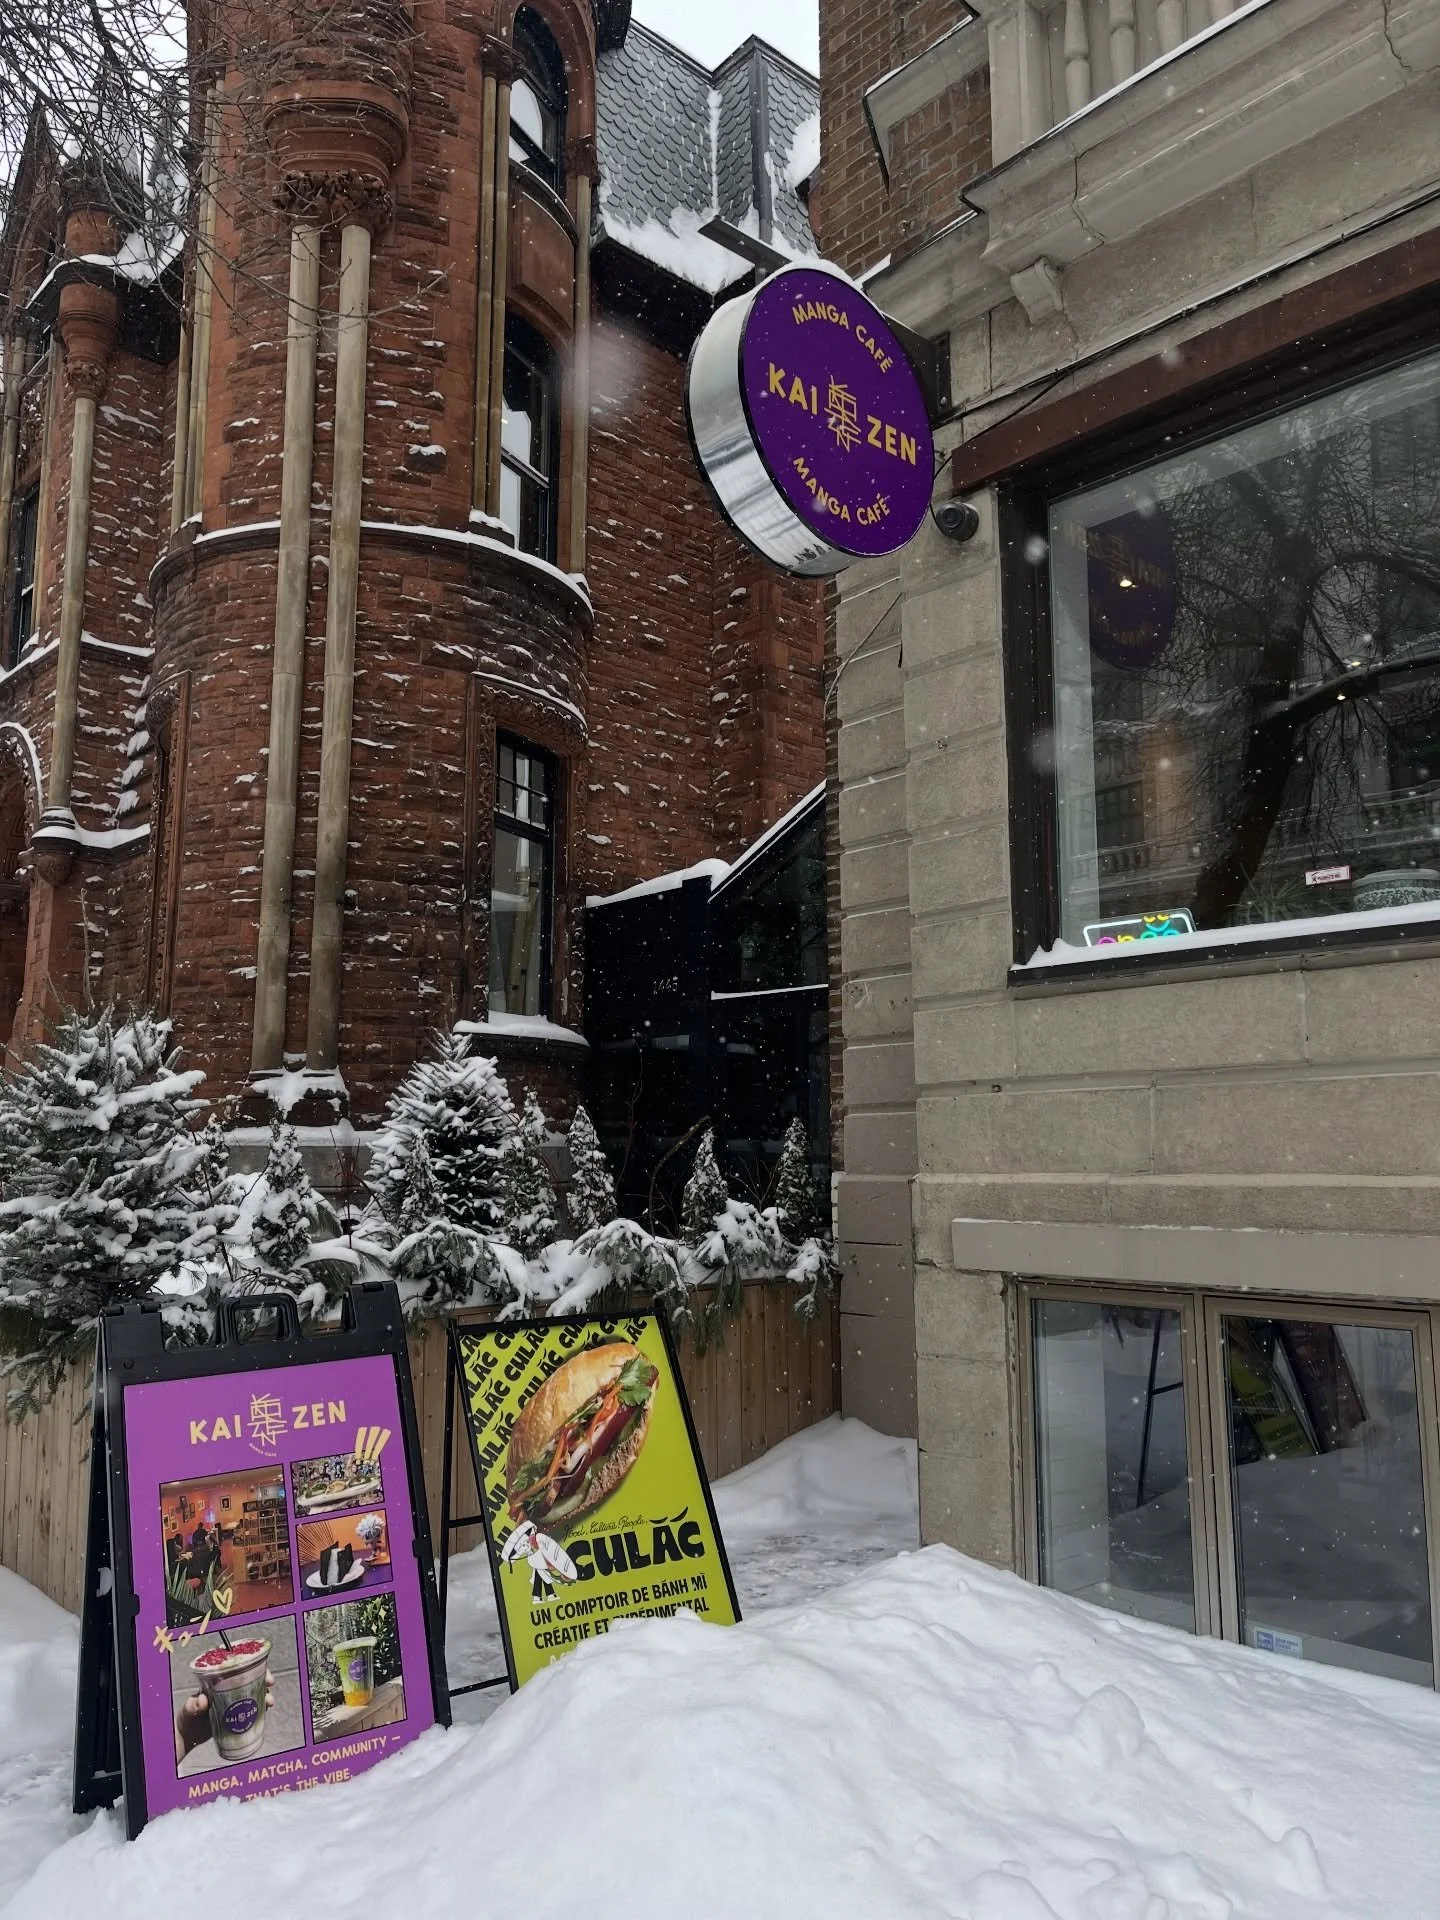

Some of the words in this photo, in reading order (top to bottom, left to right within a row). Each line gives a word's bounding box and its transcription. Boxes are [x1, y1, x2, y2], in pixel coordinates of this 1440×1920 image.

[792, 302, 849, 330] MANGA
[855, 324, 894, 373] CAFÉ
[768, 362, 818, 416] KAI
[866, 415, 916, 465] ZEN
[793, 457, 851, 522] MANGA
[856, 493, 891, 526] CAFÉ
[189, 1414, 242, 1445] KAI
[291, 1400, 347, 1430] ZEN
[530, 1608, 552, 1627] UN
[555, 1591, 630, 1621] COMPTOIR
[632, 1586, 650, 1605] DE
[534, 1622, 591, 1650] CRÉATIF
[594, 1618, 610, 1637] ET
[311, 1736, 387, 1766] COMMUNITY
